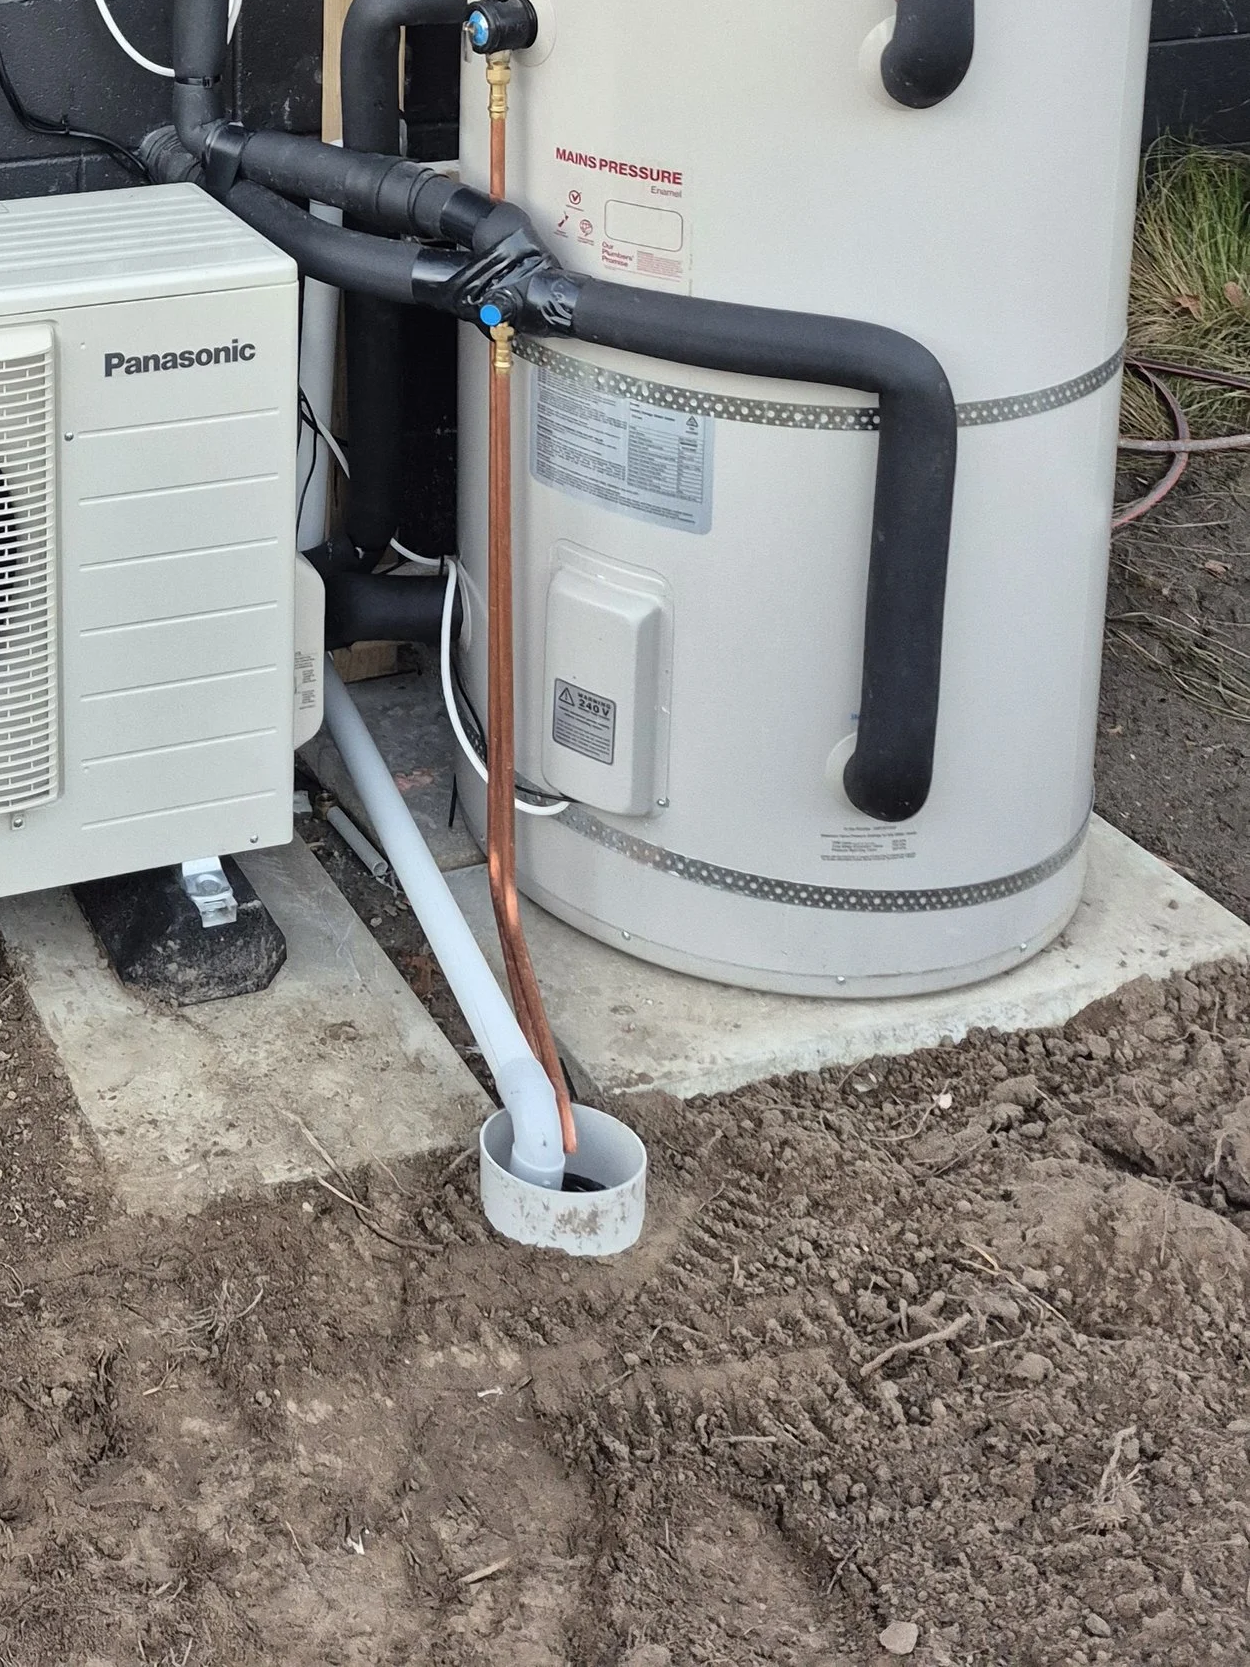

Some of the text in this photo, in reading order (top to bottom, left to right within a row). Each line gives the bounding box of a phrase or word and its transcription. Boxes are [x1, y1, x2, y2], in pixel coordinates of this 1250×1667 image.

[556, 147, 683, 185] MAINS PRESSURE
[650, 185, 682, 198] Enamel
[104, 338, 256, 377] Panasonic
[577, 692, 612, 709] WARNING
[579, 699, 600, 713] 240
[602, 707, 610, 716] V
